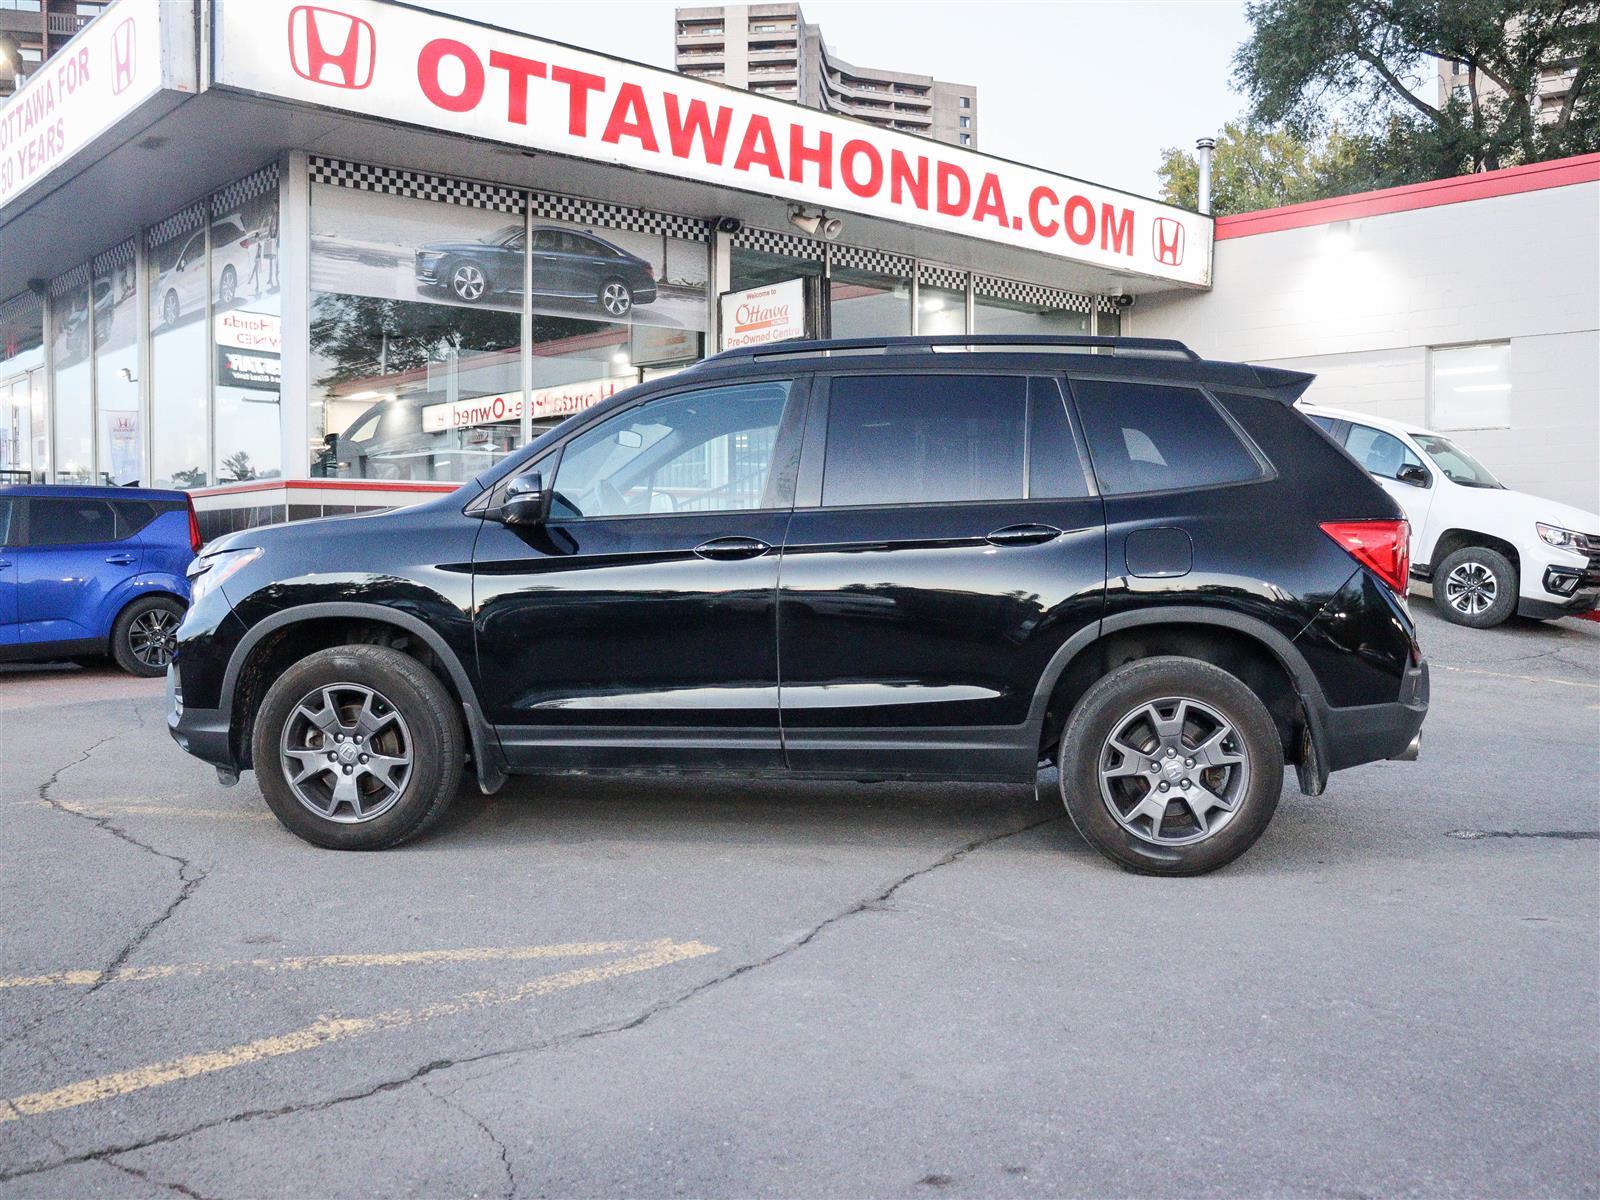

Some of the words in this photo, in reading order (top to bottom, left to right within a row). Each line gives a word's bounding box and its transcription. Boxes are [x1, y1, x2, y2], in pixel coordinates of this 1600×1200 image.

[0, 79, 55, 151] OTTAWA
[58, 46, 90, 105] FOR
[1, 157, 14, 195] 50
[18, 117, 65, 180] YEARS
[417, 38, 1136, 258] OTTAWAHONDA.COM
[735, 303, 790, 325] Ottawa
[746, 292, 770, 301] Welcome
[727, 332, 771, 348] Pre-Owned
